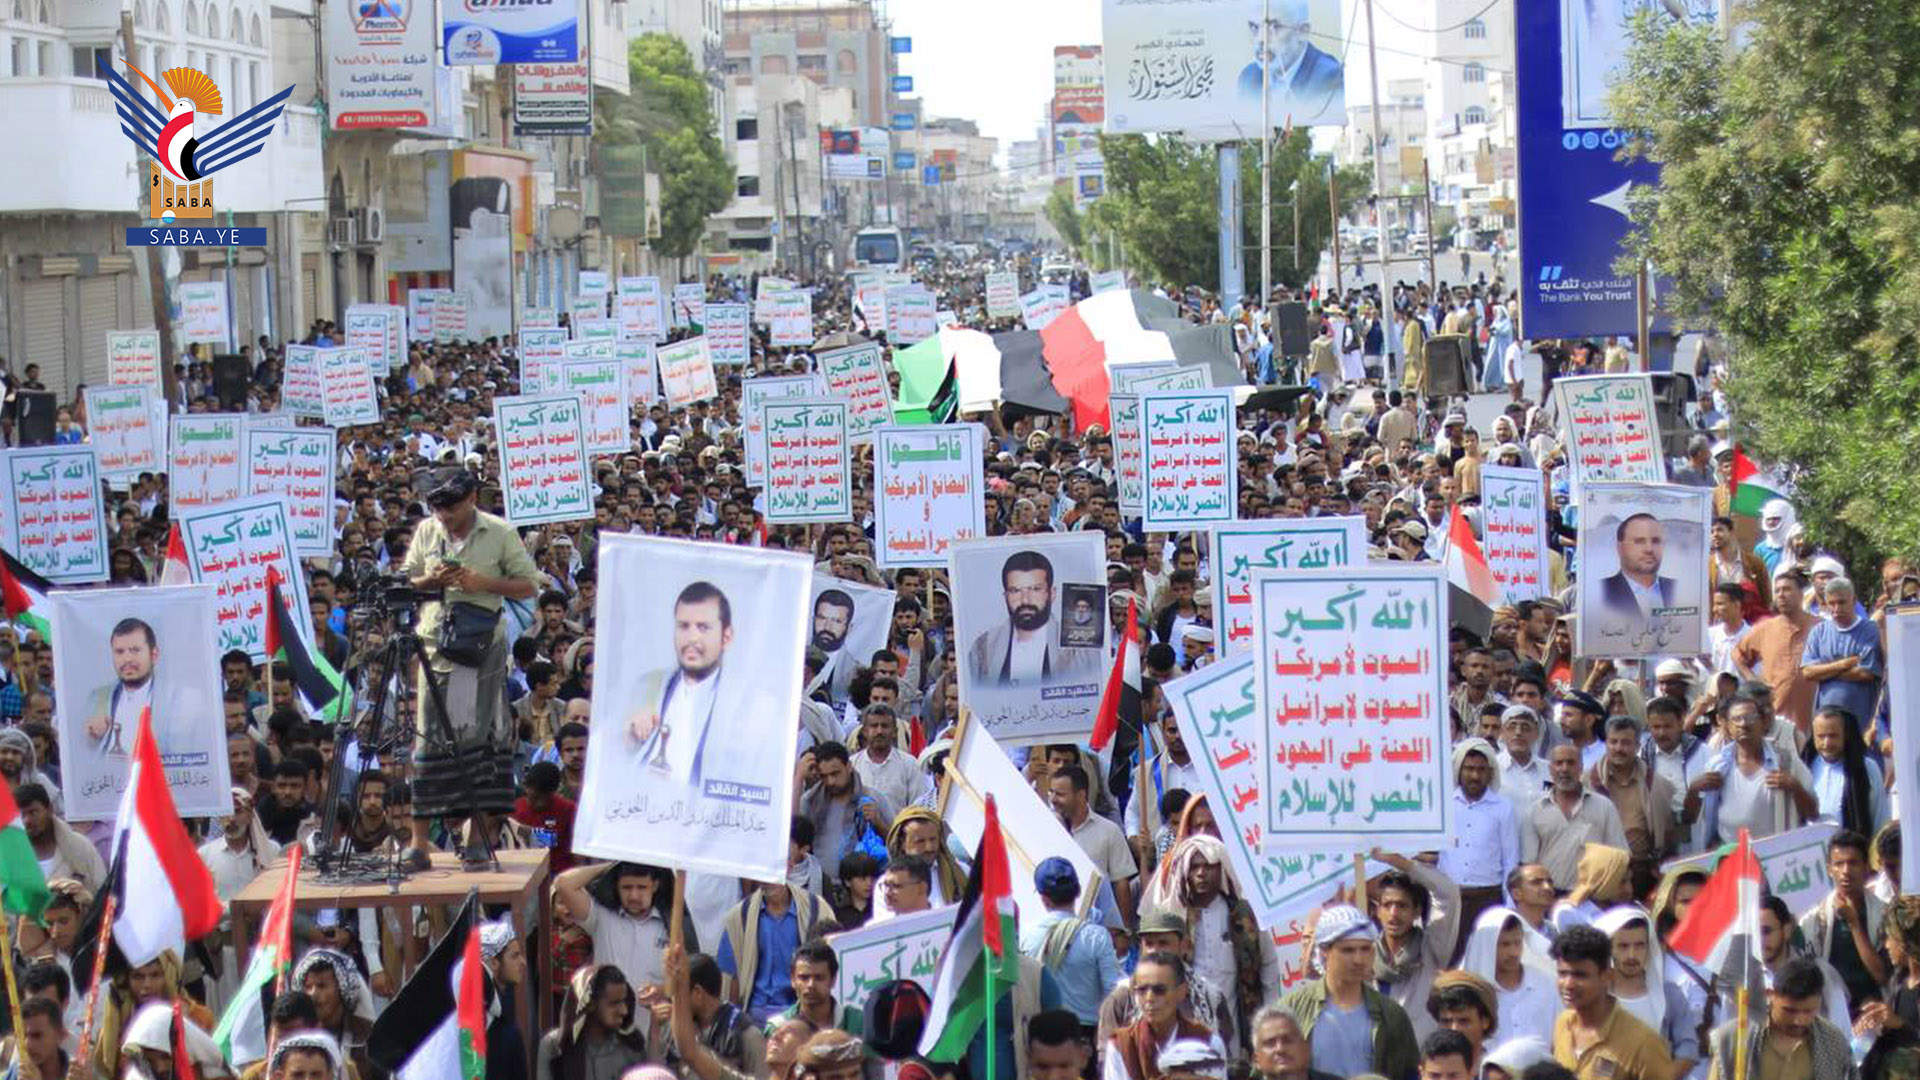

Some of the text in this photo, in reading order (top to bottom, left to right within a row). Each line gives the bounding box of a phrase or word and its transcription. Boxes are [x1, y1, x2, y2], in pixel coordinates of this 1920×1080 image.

[1540, 290, 1632, 303] The Bank You Trust
[1615, 383, 1643, 400] الله
[506, 403, 576, 433] الله أكبر
[769, 407, 812, 434] أكبر
[815, 408, 841, 427] الله
[1151, 401, 1224, 430] الله أكبر
[300, 438, 326, 456] الله
[548, 429, 578, 446] الموت
[811, 434, 841, 449] الموت
[1193, 431, 1225, 447] الموت
[549, 450, 580, 466] الموت
[811, 453, 842, 468] الموت
[885, 434, 961, 469] قاطعوا
[1193, 453, 1225, 468] الموت
[63, 460, 91, 479] الله
[559, 469, 582, 483] اللعنة
[819, 472, 842, 484] اللعنة
[1201, 473, 1225, 486] اللعنة
[511, 474, 537, 491] اليهود
[771, 474, 797, 488] اليهود
[932, 474, 970, 499] البضائع
[1151, 475, 1178, 490] اليهود
[553, 485, 584, 510] النصر
[813, 488, 843, 510] النصر
[1193, 490, 1226, 515] النصر
[198, 513, 281, 553] الله أكبر
[249, 545, 285, 567] الموت
[1225, 536, 1340, 581] الله أكبر
[1273, 583, 1367, 644] أكبر
[1372, 588, 1429, 629] الله
[1363, 648, 1429, 681] الموت
[1205, 677, 1255, 737] كبر
[1364, 692, 1430, 725] الموت
[1277, 738, 1333, 769] اليهود
[1381, 736, 1431, 763] اللعنة
[707, 781, 769, 802] السيد القائد
[1363, 773, 1432, 823] النصر
[1776, 858, 1825, 895] الله
